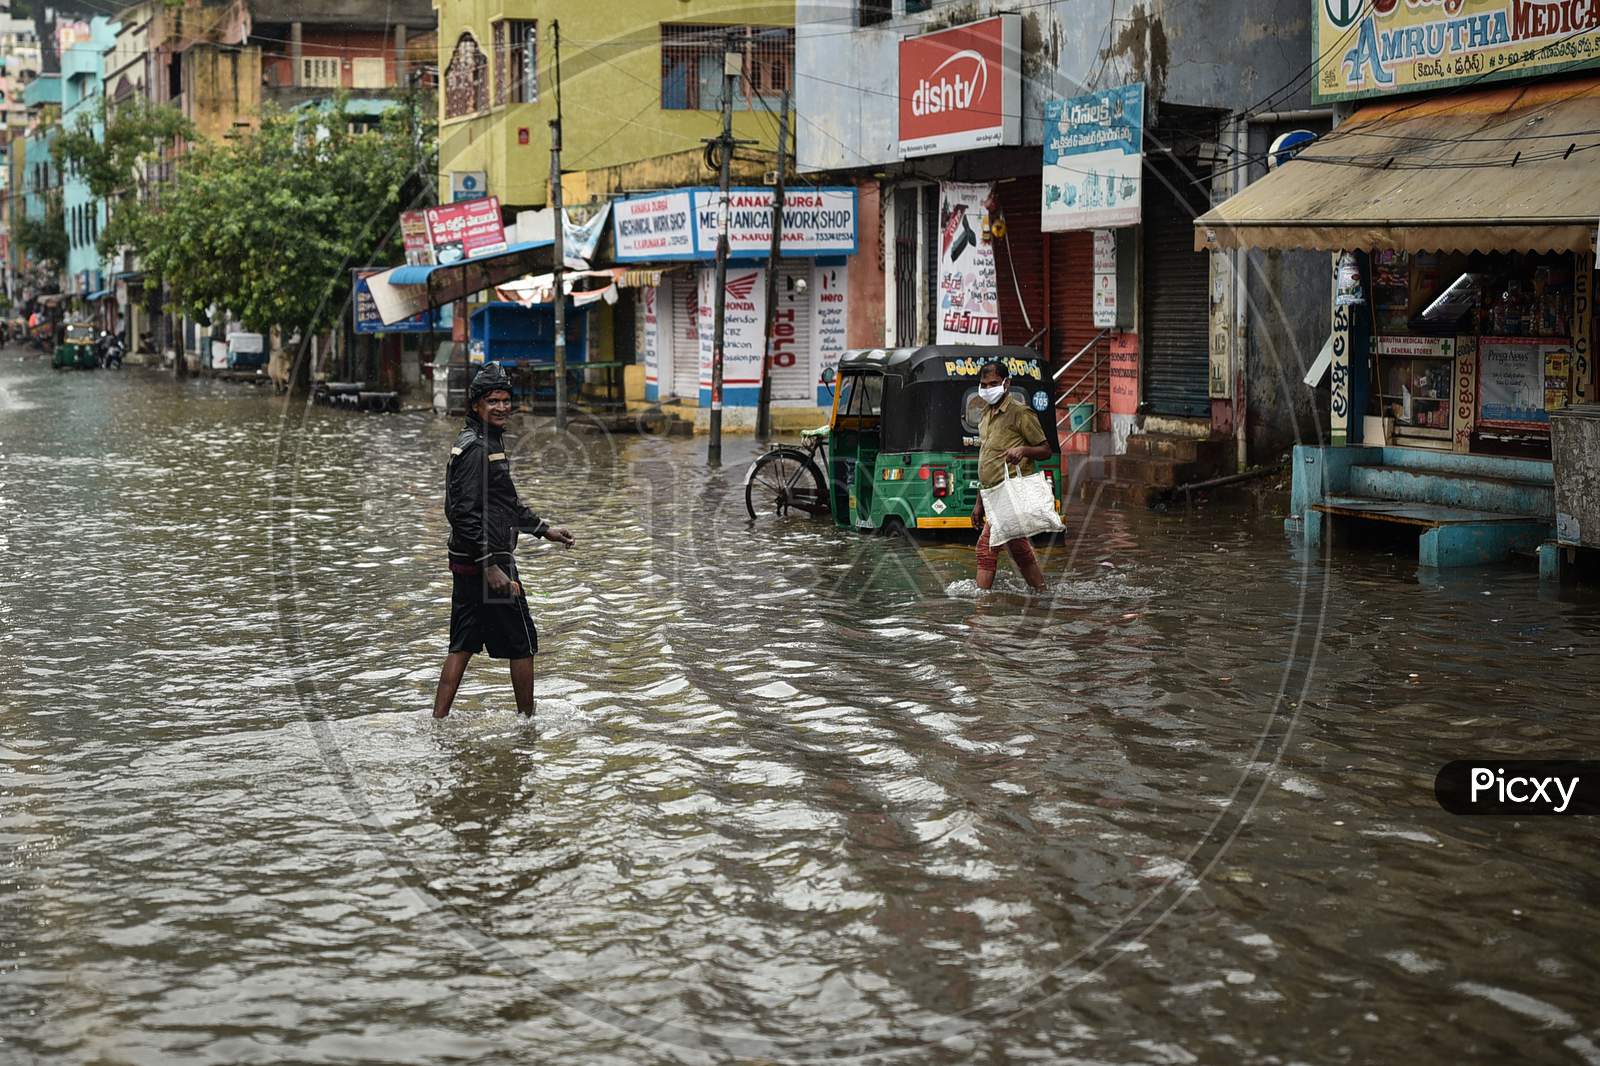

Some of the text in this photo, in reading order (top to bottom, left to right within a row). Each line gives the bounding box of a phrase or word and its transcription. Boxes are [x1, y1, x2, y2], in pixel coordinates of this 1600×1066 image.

[1343, 12, 1510, 84] AMRUTHA
[912, 59, 984, 117] dishtv
[781, 210, 851, 229] WORKSHOP
[820, 293, 843, 303] Hero
[1403, 337, 1424, 345] MEDICAL
[1424, 337, 1440, 346] FANCY
[1033, 397, 1048, 407] 705
